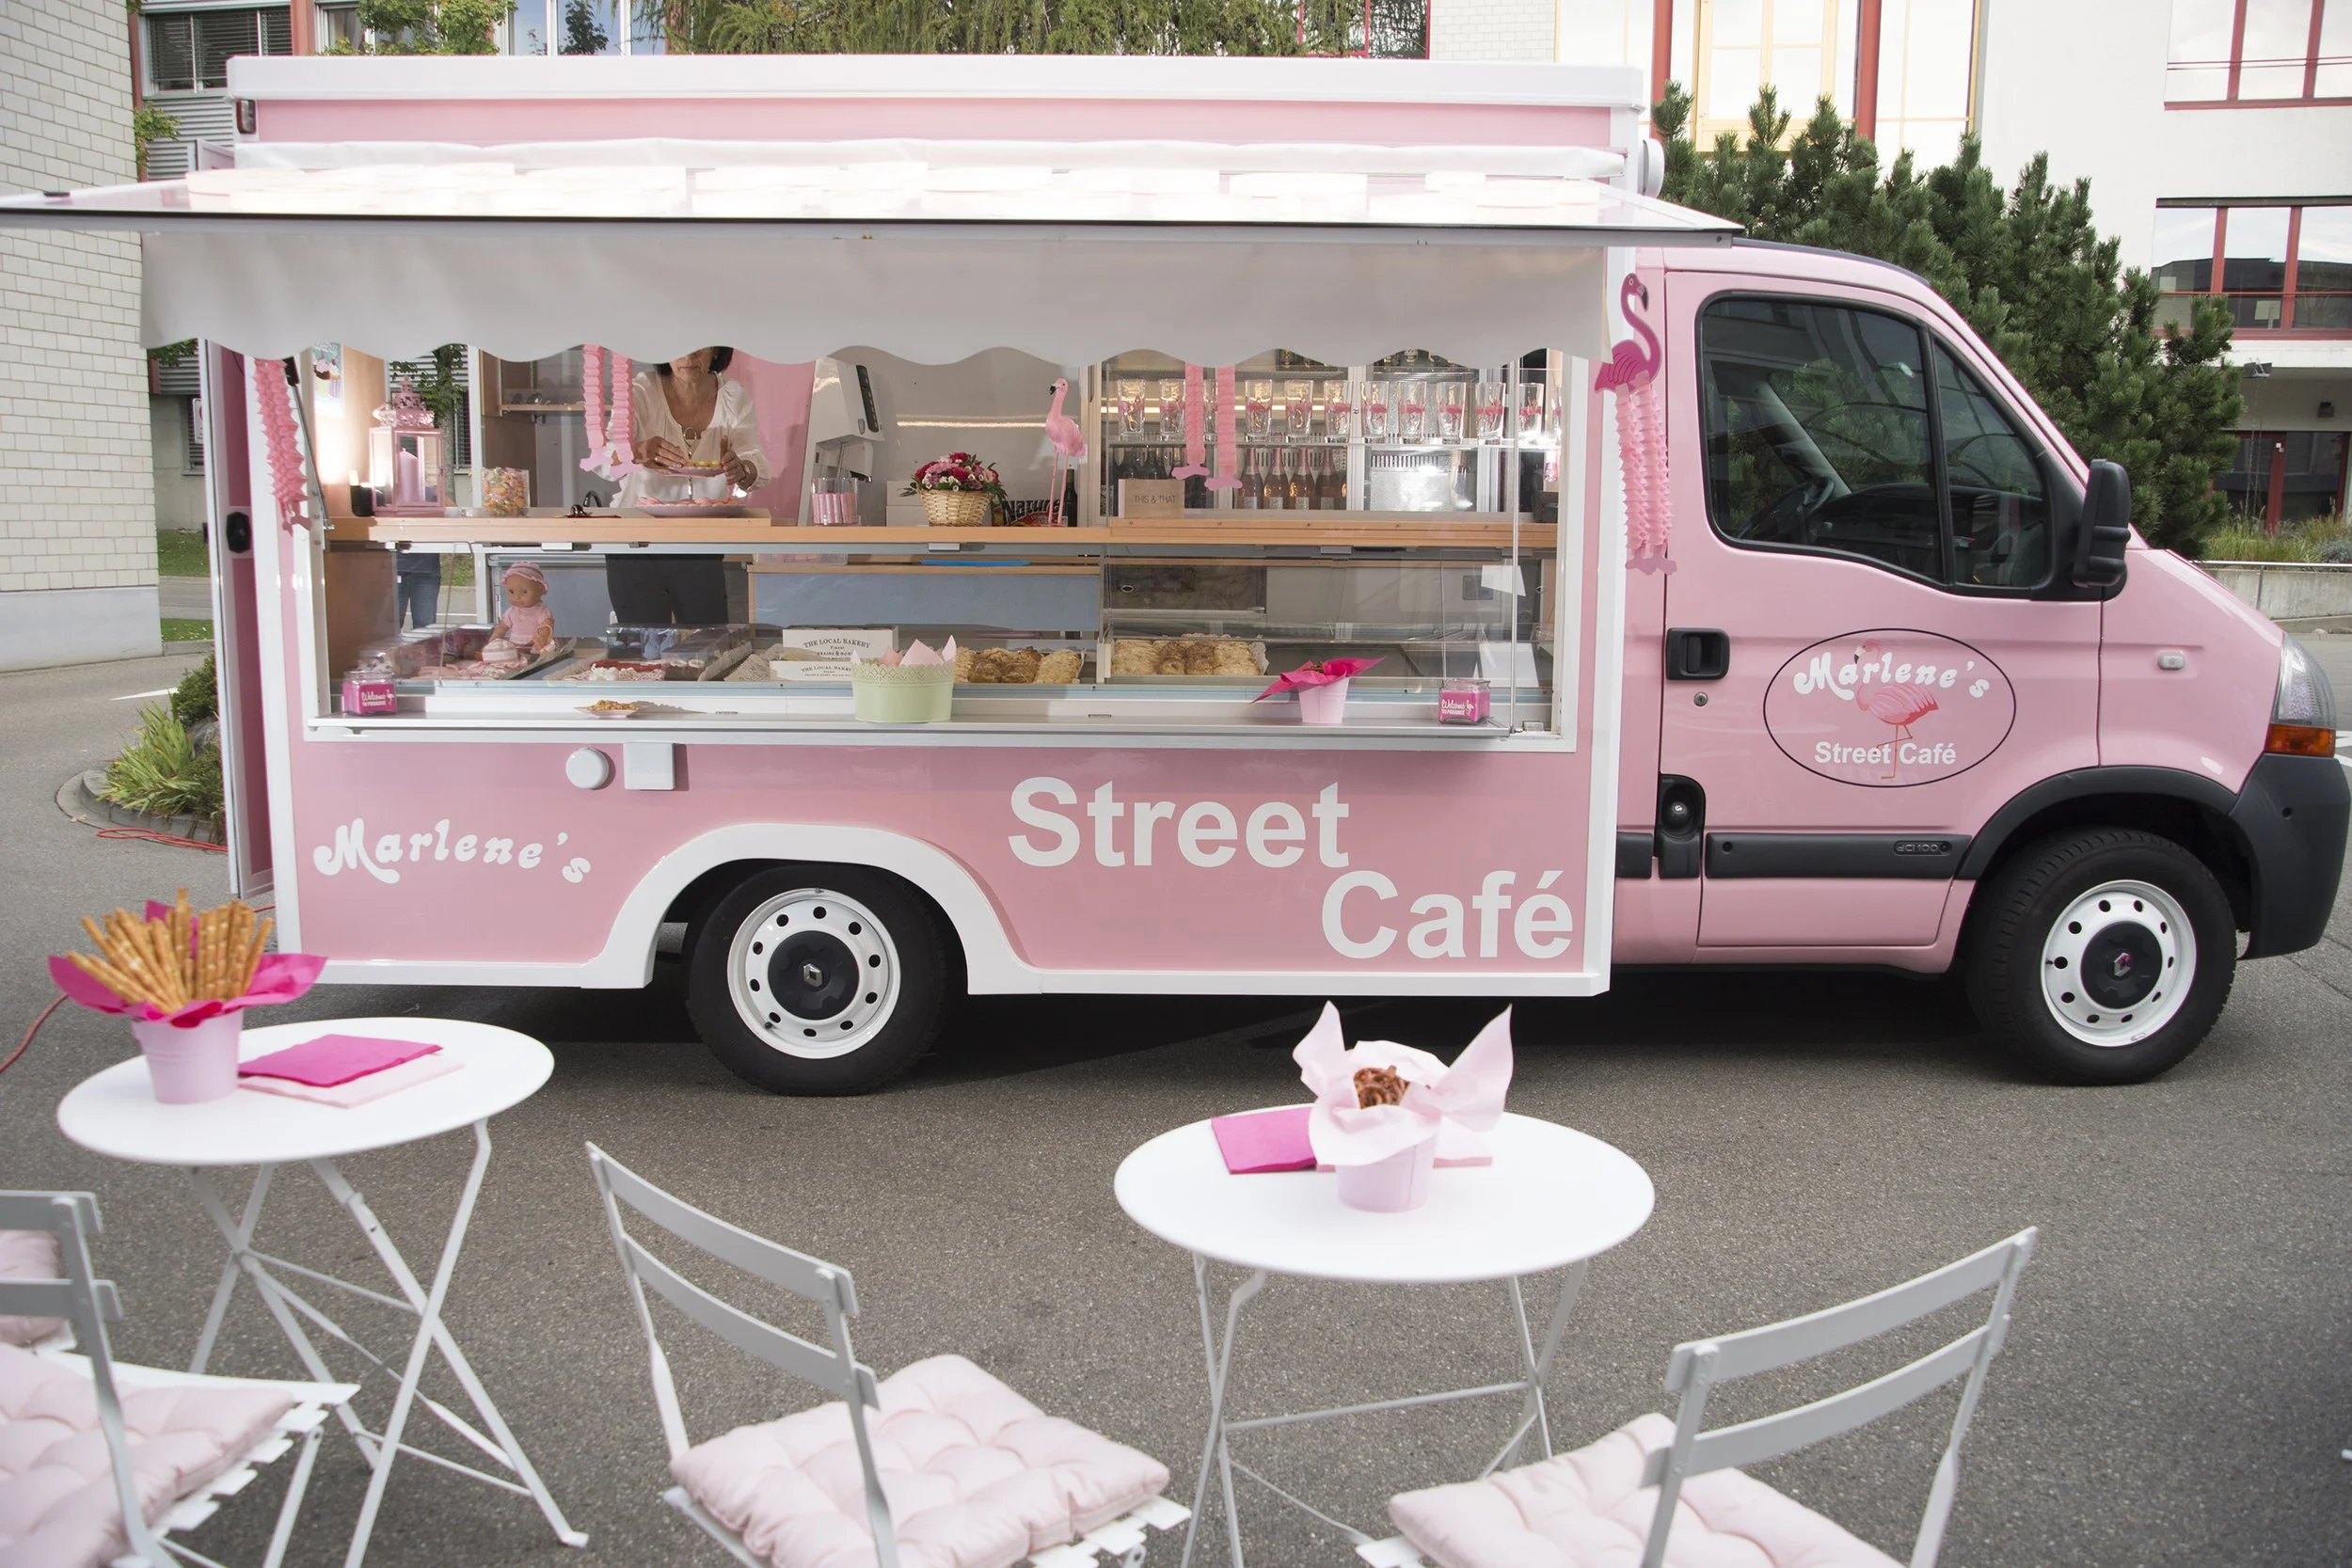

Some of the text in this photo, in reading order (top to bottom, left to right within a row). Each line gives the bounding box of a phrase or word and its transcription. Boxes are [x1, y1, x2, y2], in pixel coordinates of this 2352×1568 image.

[1135, 495, 1177, 504] THIS & THAT
[803, 640, 818, 648] THE
[843, 638, 871, 648] BAKERY
[1793, 651, 1990, 701] Marlene's
[1814, 741, 1957, 764] Street Café
[1009, 776, 1350, 868] Street
[313, 817, 592, 883] Marlene's
[1322, 869, 1574, 959] Café
